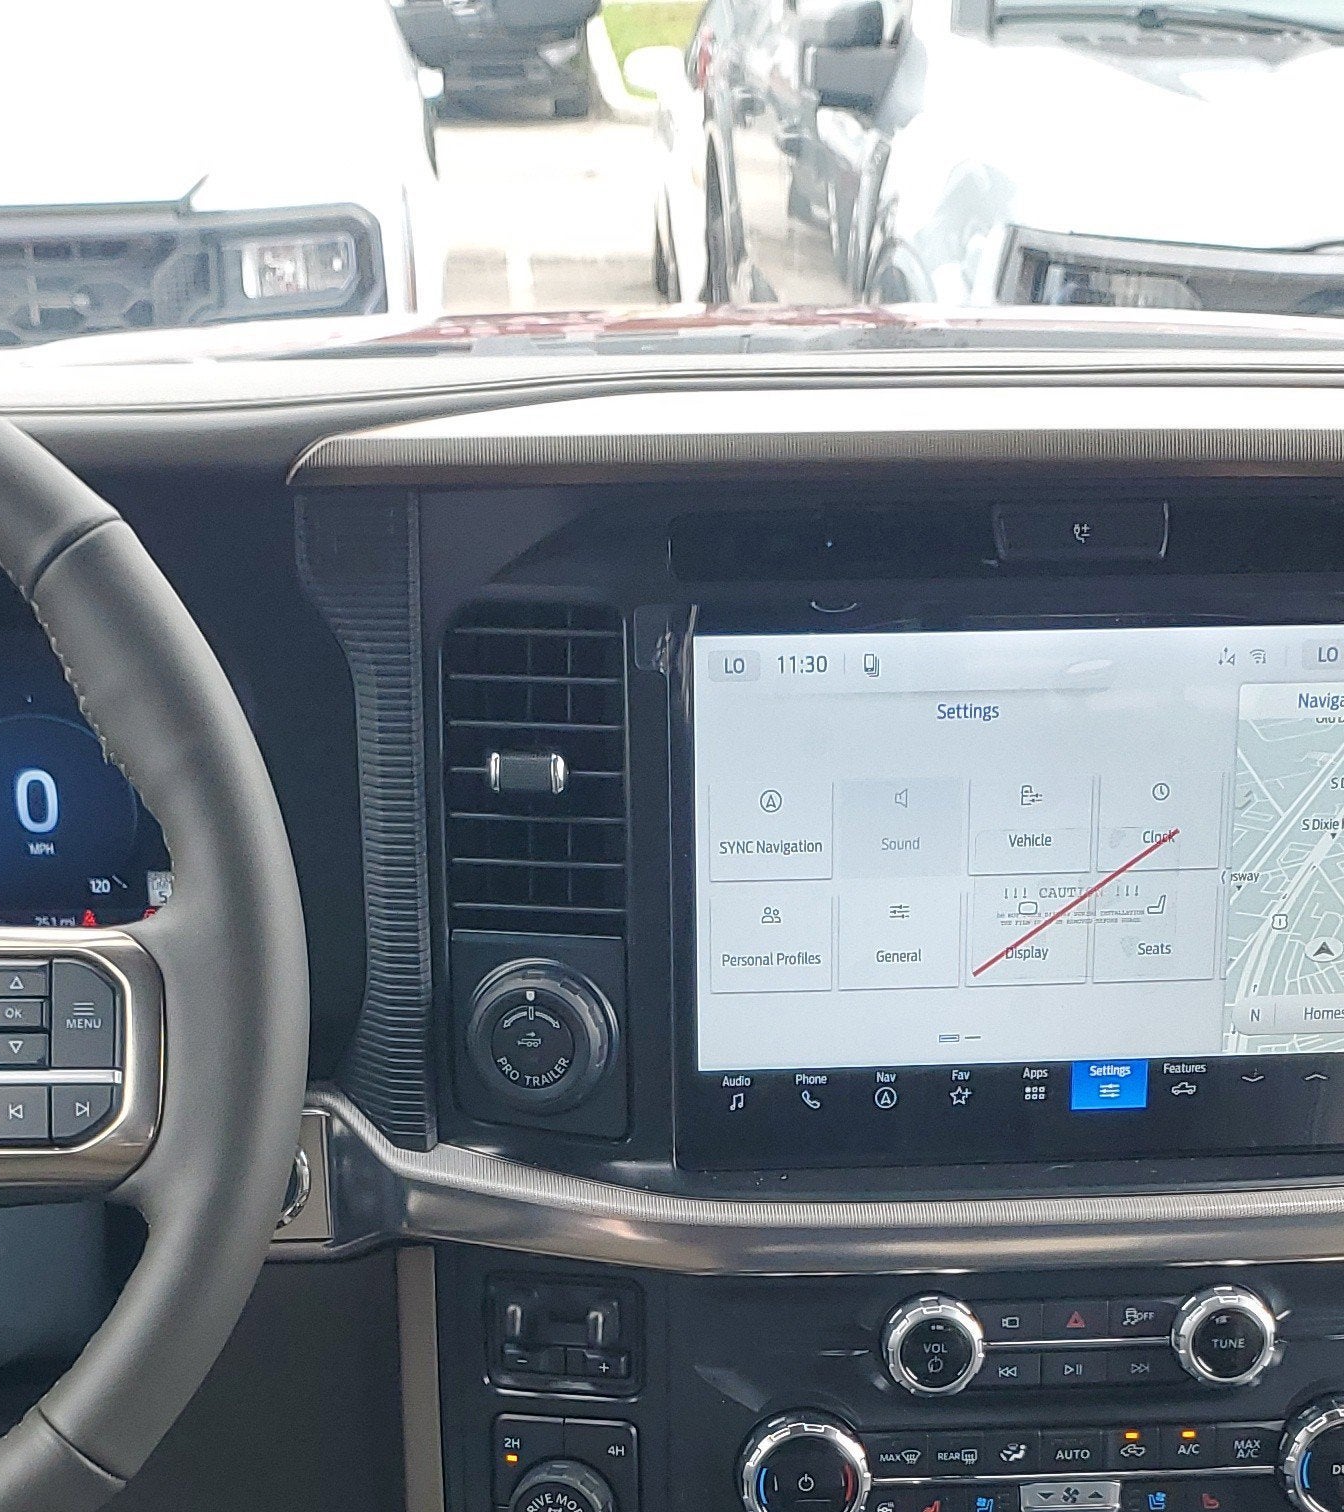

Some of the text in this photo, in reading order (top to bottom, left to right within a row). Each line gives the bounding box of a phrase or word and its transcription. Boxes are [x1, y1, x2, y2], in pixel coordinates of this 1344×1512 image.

[1318, 646, 1338, 663] LO
[724, 657, 745, 674] LO
[776, 655, 828, 674] 11:30
[937, 703, 1000, 721] Settings
[1331, 779, 1338, 789] S
[15, 768, 59, 834] 0
[1302, 819, 1309, 830] S
[1312, 818, 1339, 830] Dixie
[881, 837, 920, 851] Sound
[1008, 833, 1052, 847] Vehicle
[29, 843, 55, 855] MPH
[719, 839, 823, 856] SYNC Navigation
[90, 878, 111, 893] 120
[1006, 945, 1049, 961] Display
[1137, 943, 1172, 955] Seats
[722, 952, 821, 967] Personal Profiles
[876, 949, 921, 963] General
[5, 1008, 22, 1019] OK
[1251, 1009, 1260, 1022] N
[66, 1018, 102, 1029] MENU
[497, 1056, 570, 1087] PRO TRAILER
[1023, 1067, 1048, 1082] Apps
[1090, 1064, 1131, 1078] Settings
[1163, 1062, 1206, 1075] Features
[722, 1075, 751, 1088] Audio
[795, 1073, 827, 1086] Phone
[876, 1071, 896, 1083] Nav
[951, 1069, 970, 1082] Fav
[1137, 1311, 1154, 1321] OFF
[923, 1343, 947, 1353] VOL
[1211, 1337, 1246, 1348] TUNE
[504, 1437, 520, 1449] 2H
[1177, 1443, 1200, 1455] A/C
[1234, 1439, 1261, 1450] MAX
[608, 1445, 625, 1456] 4H
[879, 1452, 901, 1462] MAX
[937, 1451, 960, 1461] REAR
[1056, 1449, 1090, 1460] AUTO
[1236, 1449, 1259, 1459] A/C
